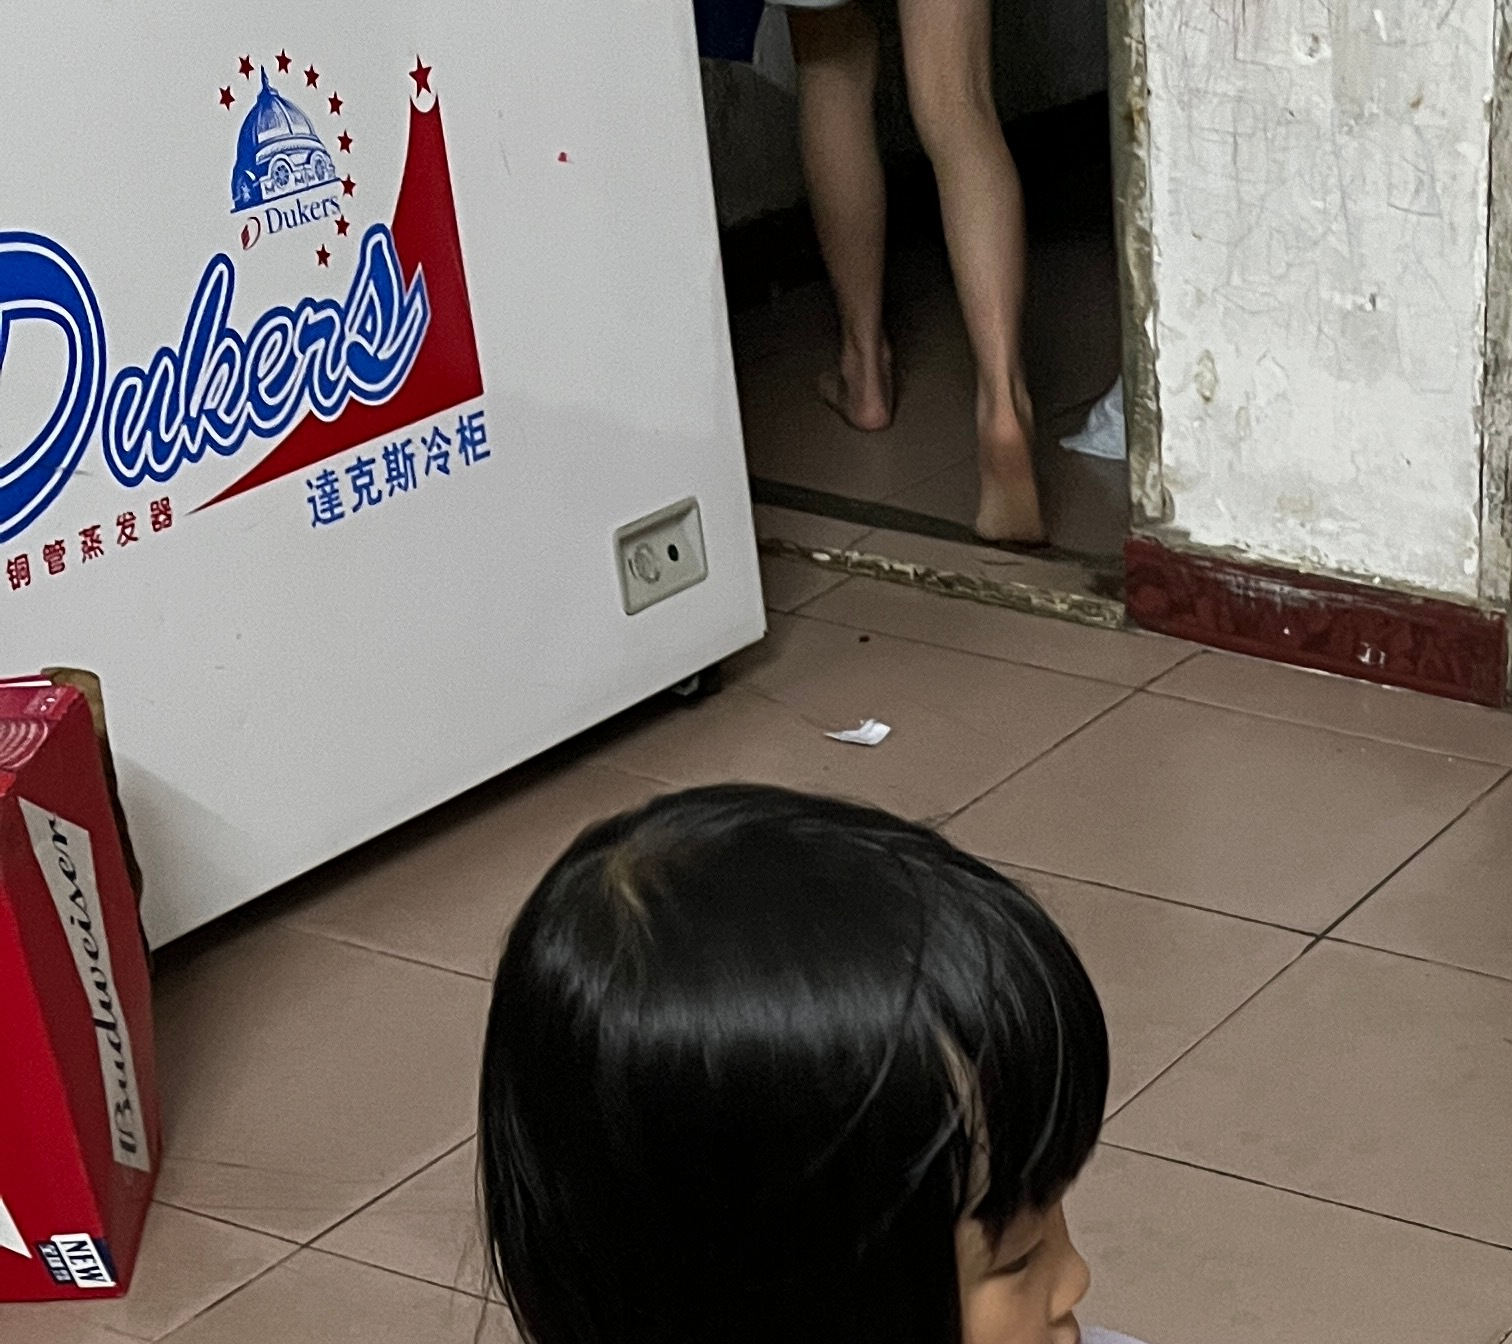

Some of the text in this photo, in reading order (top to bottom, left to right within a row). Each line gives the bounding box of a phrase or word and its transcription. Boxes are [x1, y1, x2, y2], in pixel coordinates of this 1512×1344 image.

[266, 192, 341, 236] Dukers
[0, 224, 432, 543] Dukers
[305, 409, 493, 529] 達克斯冷柜
[5, 497, 174, 592] 铜管蒸发器
[48, 812, 138, 1157] Budweiser
[60, 1239, 108, 1285] NEW
